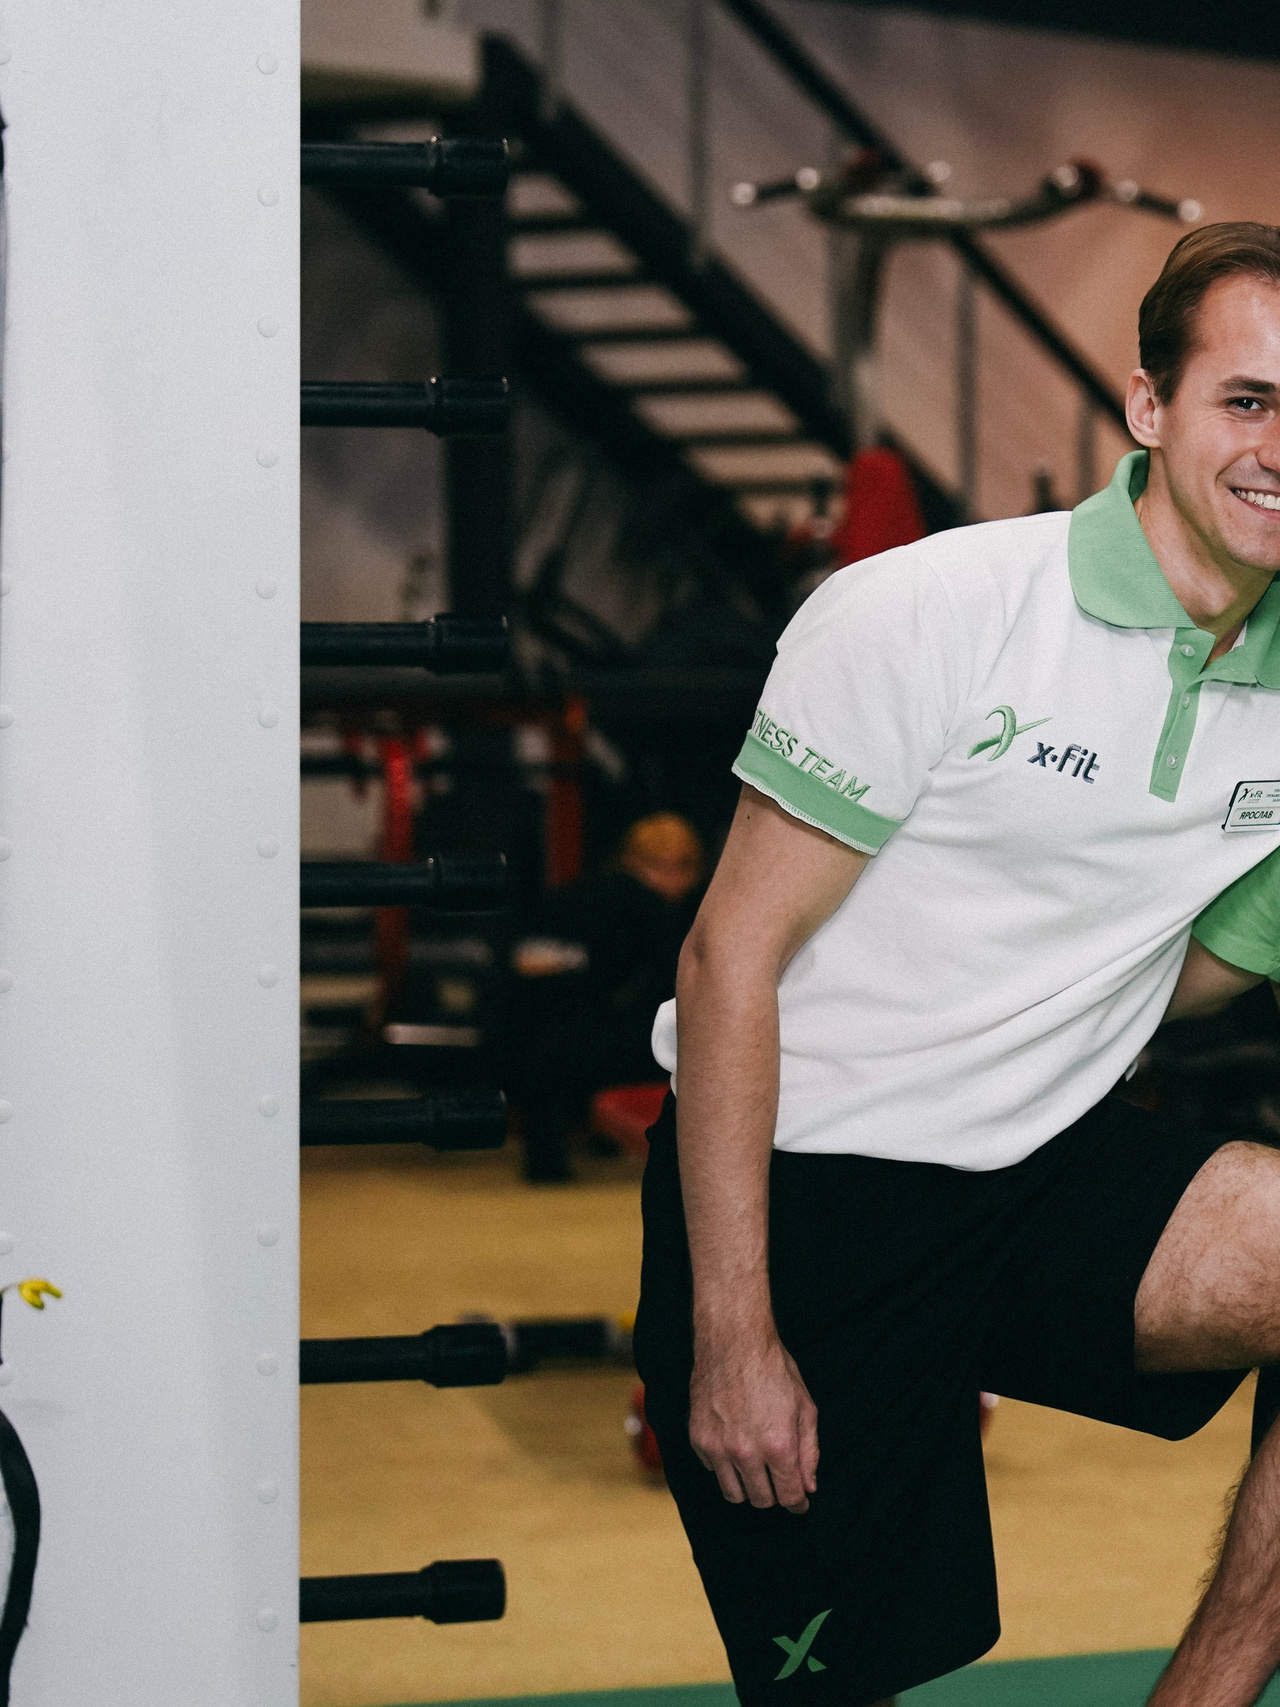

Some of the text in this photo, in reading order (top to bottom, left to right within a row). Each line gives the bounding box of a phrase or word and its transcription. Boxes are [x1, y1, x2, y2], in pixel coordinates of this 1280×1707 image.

[751, 709, 872, 803] TNESS TEAM
[1238, 810, 1274, 820] ЯРОСЛАВ
